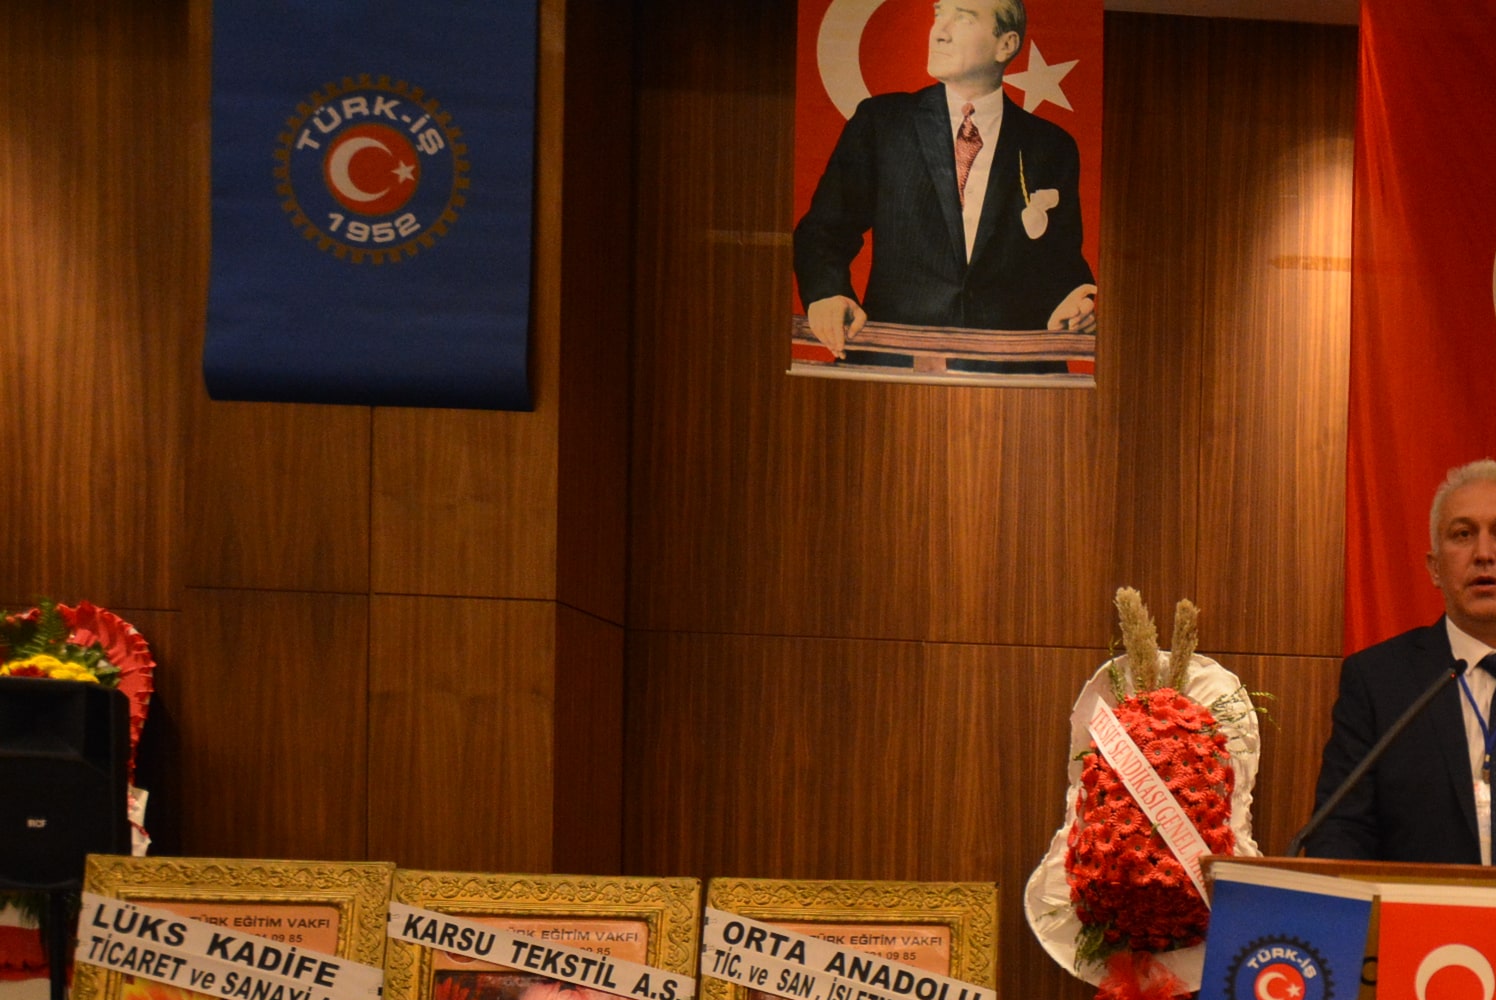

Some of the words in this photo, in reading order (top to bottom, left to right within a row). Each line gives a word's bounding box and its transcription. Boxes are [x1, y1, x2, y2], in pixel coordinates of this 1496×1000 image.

[297, 95, 445, 155] TÜRK-İŞ
[328, 212, 421, 243] 1952
[233, 915, 281, 928] EĞİTİM
[287, 919, 330, 929] VAKFI
[541, 928, 590, 941] EĞİTİM
[595, 931, 638, 942] VAKFI
[850, 934, 897, 946] EĞİTİM
[901, 936, 942, 946] VAKFI
[88, 933, 187, 981] TİCARET
[190, 968, 216, 989] ve
[91, 903, 188, 946] LÜKS
[206, 932, 340, 988] KADİFE
[402, 913, 496, 956] KARSU
[510, 939, 617, 989] TEKSTİL
[723, 921, 806, 964] ORTA
[712, 948, 743, 980] TİC.
[749, 966, 769, 986] ve
